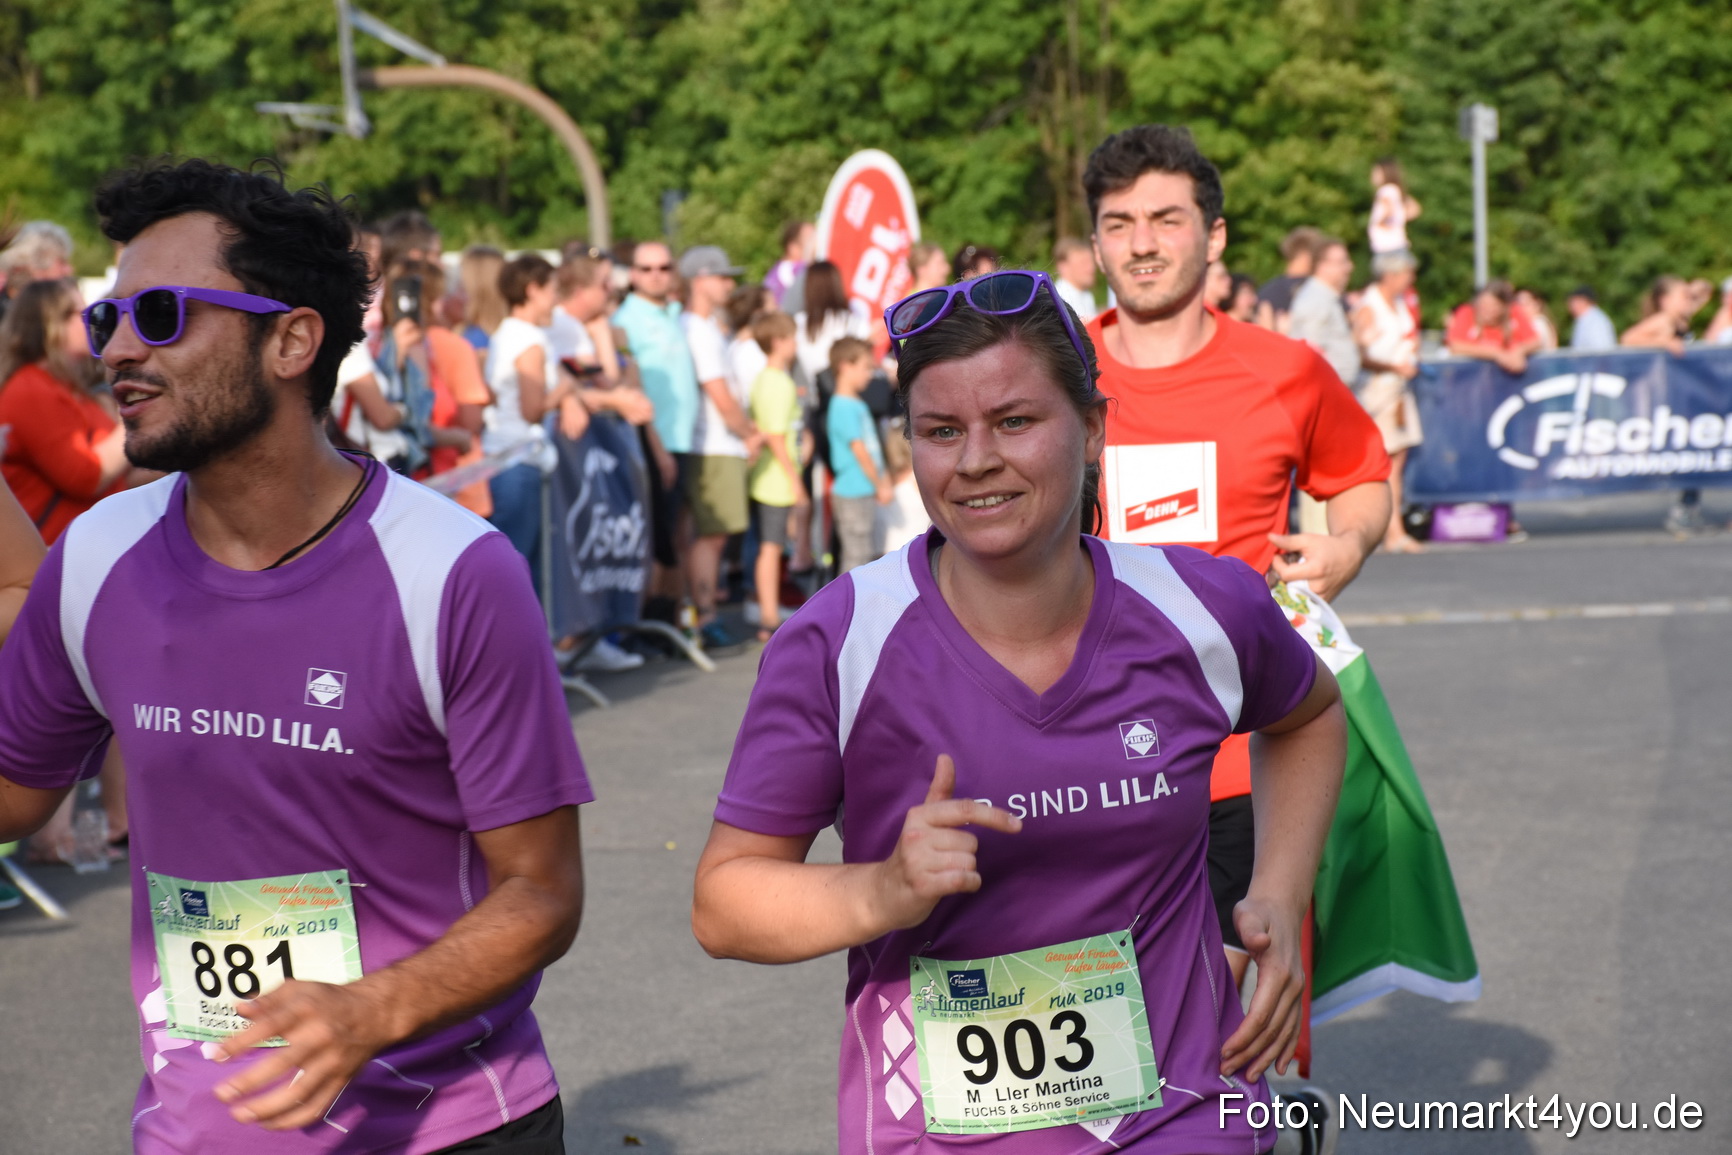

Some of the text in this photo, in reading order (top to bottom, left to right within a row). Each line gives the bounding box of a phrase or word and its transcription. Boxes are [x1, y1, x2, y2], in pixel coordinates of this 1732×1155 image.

[133, 703, 355, 755] WIR SIND LILA.
[1124, 733, 1158, 745] FUCHS
[1008, 772, 1179, 821] SIND LILA.
[297, 917, 339, 935] 2019
[1044, 949, 1086, 963] Gesunde
[191, 939, 296, 1000] 881
[938, 986, 1026, 1013] firmenlauf
[1083, 981, 1126, 1003] 2019
[956, 1009, 1095, 1085] 903
[1035, 1073, 1104, 1098] Martina
[964, 1090, 1111, 1118] FUCHS & Söhne Service
[1093, 1119, 1111, 1128] LILA
